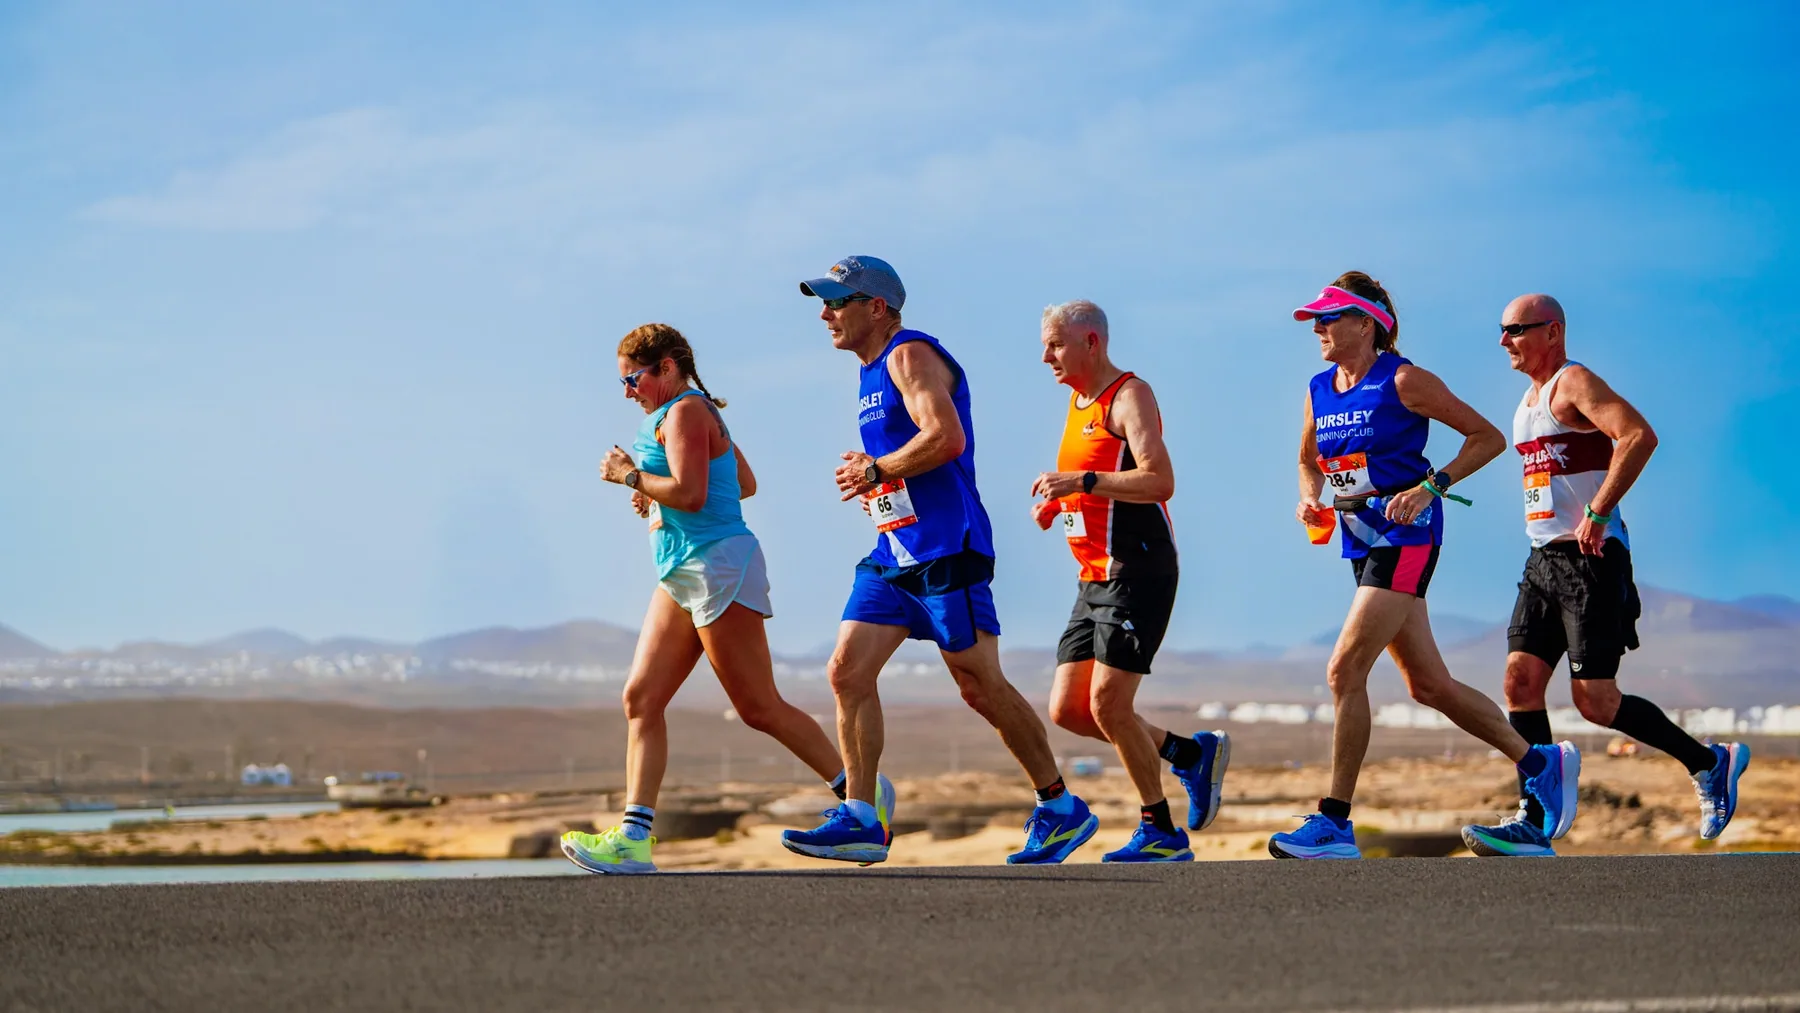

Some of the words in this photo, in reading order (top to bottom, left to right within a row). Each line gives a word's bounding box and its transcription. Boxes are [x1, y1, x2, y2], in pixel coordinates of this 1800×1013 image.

[869, 409, 887, 421] CLUB
[1316, 429, 1347, 443] UNNING
[1347, 427, 1374, 438] CLUB
[877, 495, 892, 513] 66
